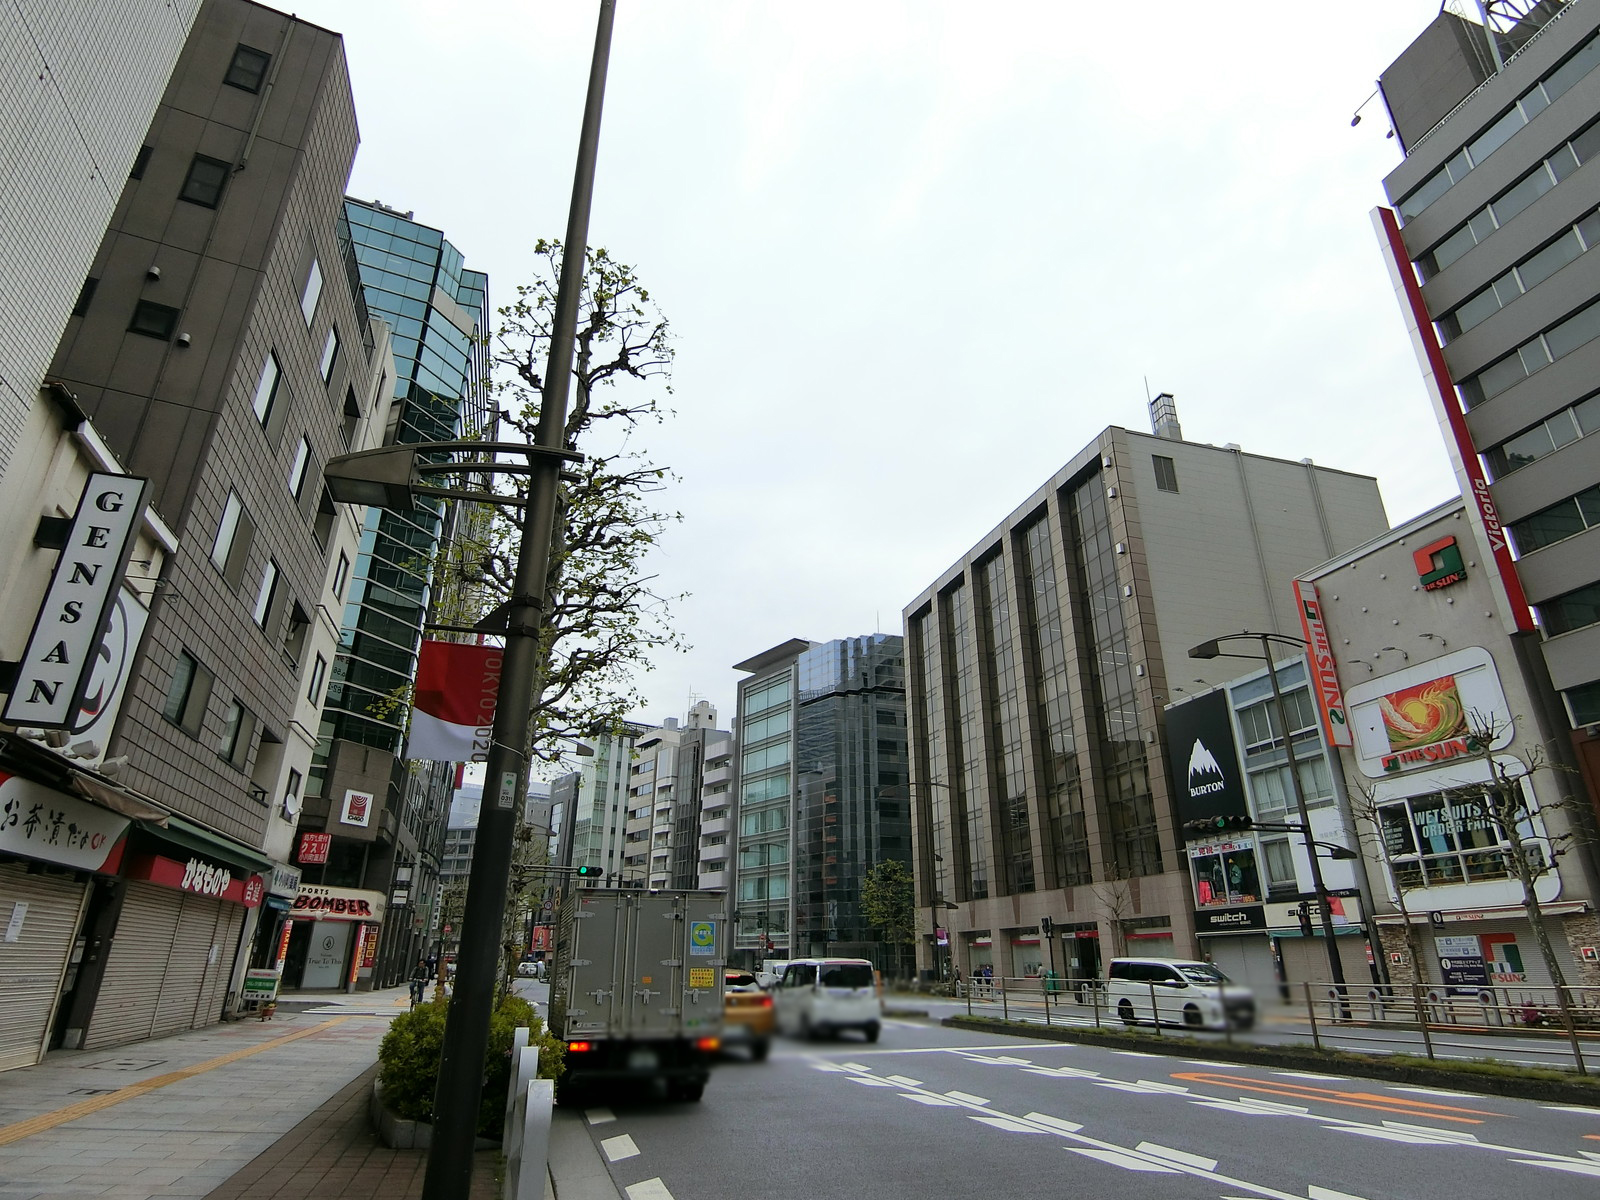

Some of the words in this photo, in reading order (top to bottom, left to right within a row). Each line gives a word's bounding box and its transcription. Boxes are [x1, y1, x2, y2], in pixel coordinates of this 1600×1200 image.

[1475, 479, 1505, 552] Victoria
[26, 491, 124, 705] GENSAN
[1422, 583, 1436, 592] THE
[1312, 622, 1329, 654] THE
[480, 649, 504, 710] TOKYO
[470, 714, 495, 764] 2020
[1397, 748, 1424, 764] THE
[1190, 780, 1225, 797] BURTON
[347, 815, 365, 823] ICHIGO
[1413, 803, 1482, 826] WETSUITS
[1422, 819, 1464, 838] ORDER
[301, 842, 327, 855] クスリ
[182, 857, 231, 897] かなものや
[292, 894, 373, 917] BOMBER
[1210, 912, 1247, 923] switch
